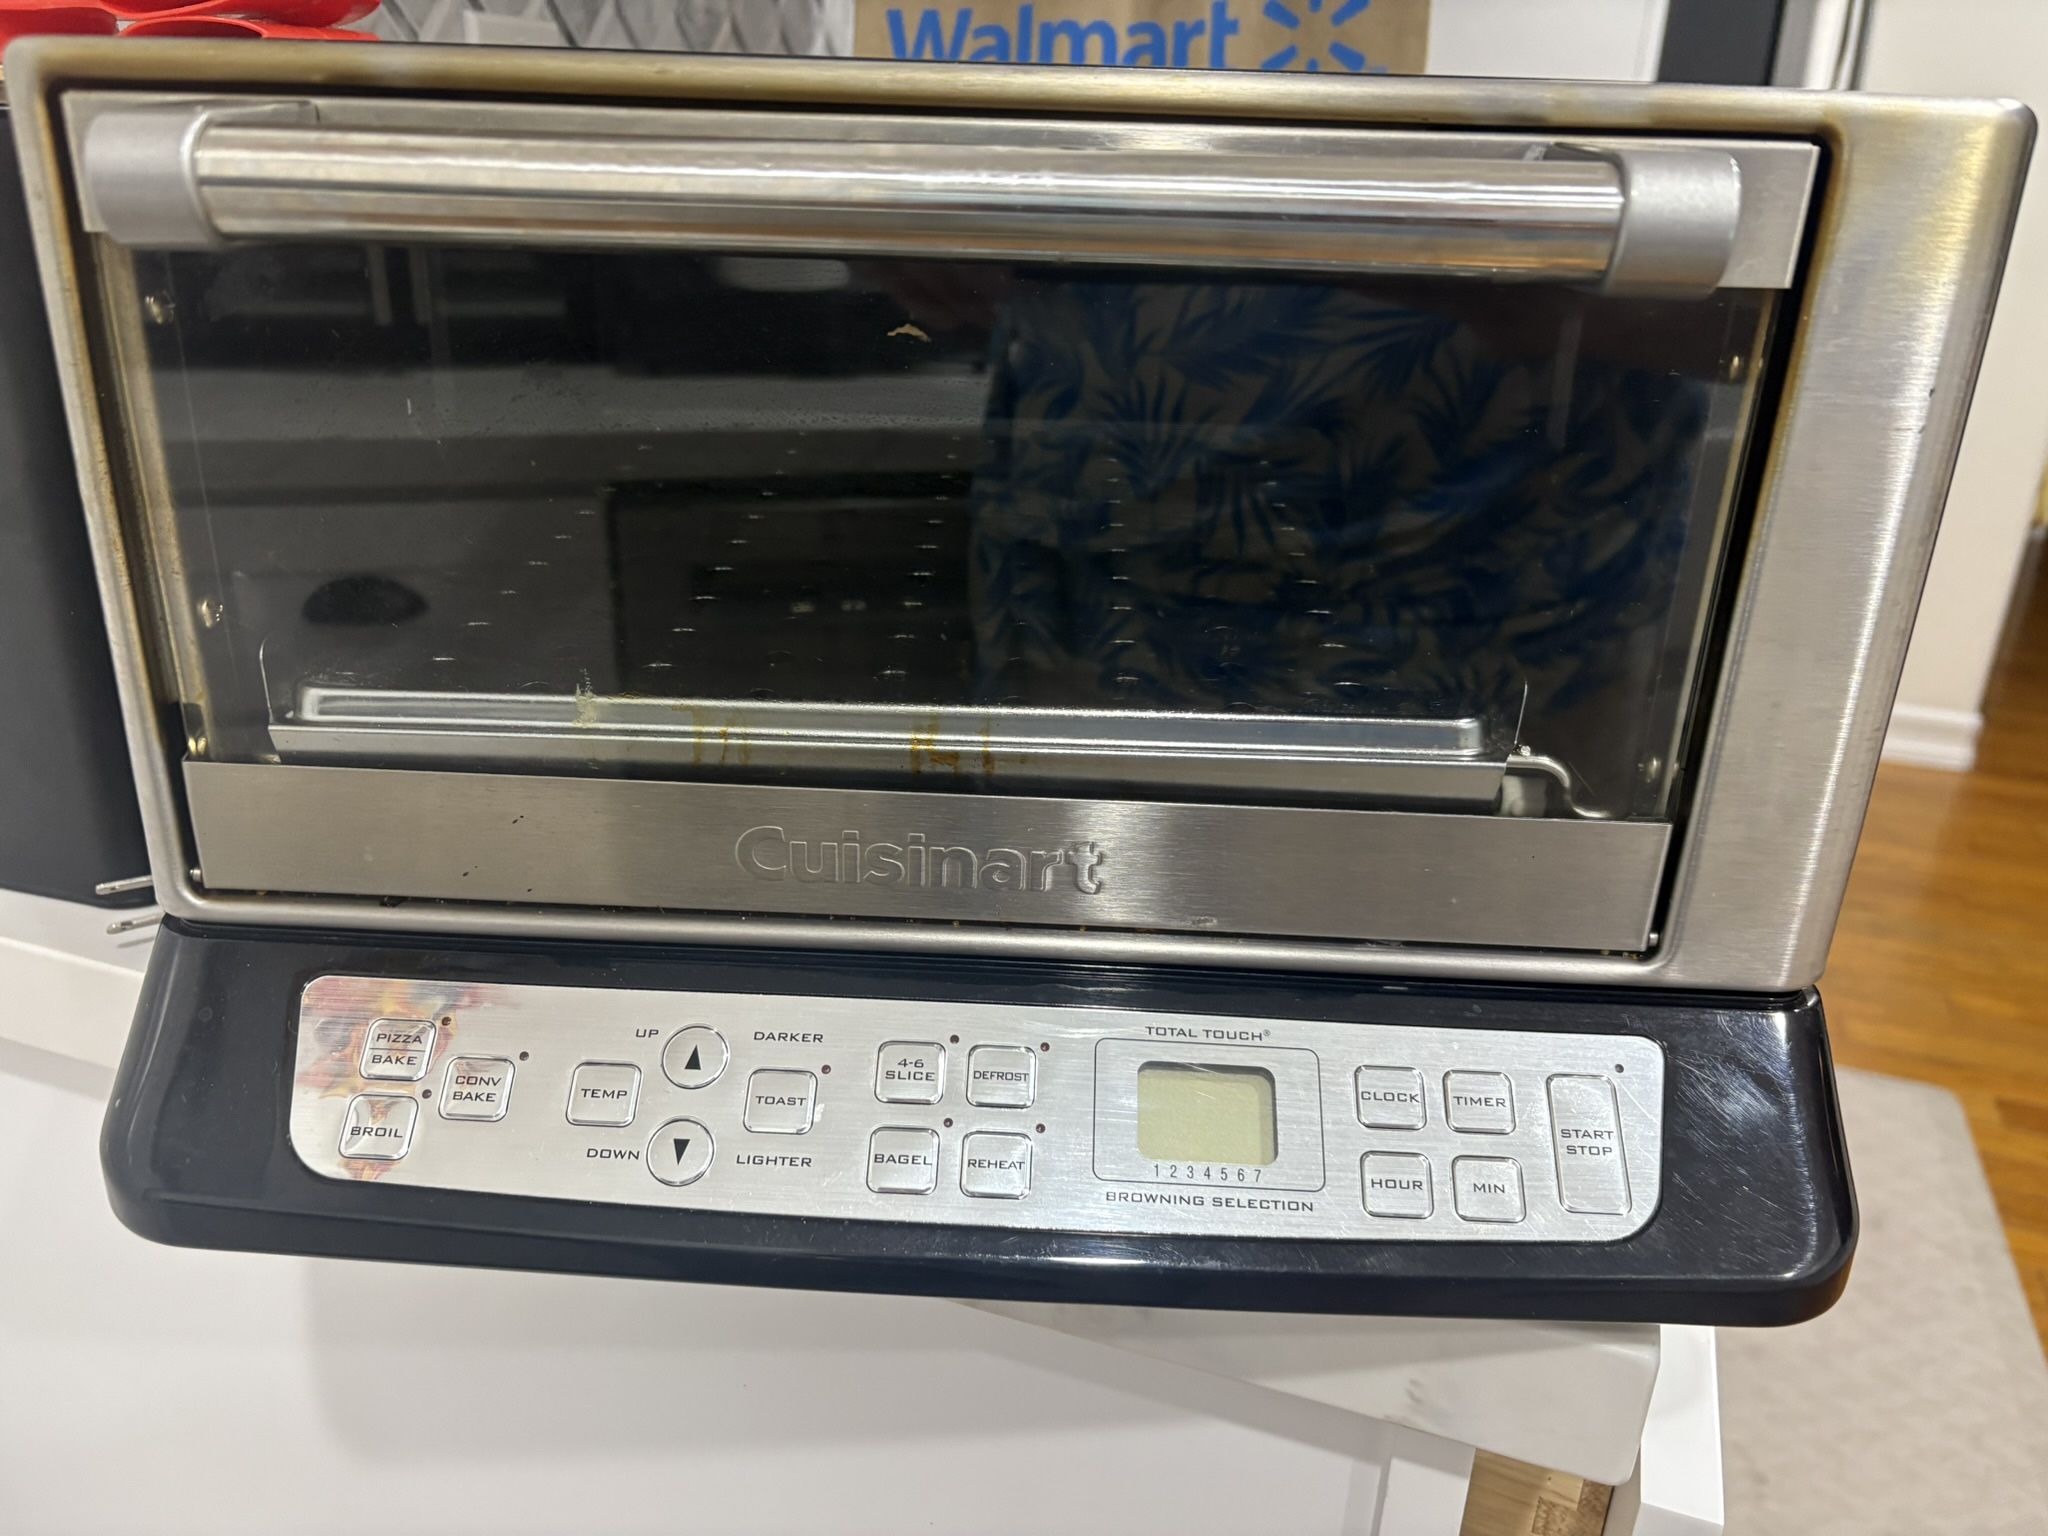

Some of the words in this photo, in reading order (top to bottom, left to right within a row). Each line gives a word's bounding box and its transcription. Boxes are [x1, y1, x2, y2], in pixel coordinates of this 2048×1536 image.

[887, 0, 1239, 69] Walmart
[735, 825, 1104, 894] Cuisinart
[636, 1028, 659, 1038] UP
[754, 1031, 824, 1043] DARKER
[1145, 1026, 1197, 1038] TOTAL
[376, 1033, 423, 1044] PIZZA
[371, 1054, 417, 1065] BAKE
[897, 1059, 924, 1068] 4-6
[455, 1075, 502, 1086] CONV
[885, 1070, 935, 1082] SLICE
[973, 1070, 1029, 1082] DEFROST
[452, 1091, 496, 1102] BAKE
[581, 1088, 628, 1099] TEMP
[1361, 1090, 1420, 1103] CLOCK
[755, 1095, 807, 1106] TOAST
[1453, 1096, 1506, 1108] TIMER
[350, 1126, 403, 1138] BROIL
[1561, 1128, 1614, 1140] START
[586, 1148, 640, 1161] DOWN
[1566, 1145, 1613, 1156] STOP
[736, 1154, 812, 1167] LIGHTER
[874, 1153, 932, 1166] BAGEL
[967, 1158, 1025, 1170] REHEAT
[1170, 1165, 1177, 1178] 2
[1187, 1165, 1194, 1179] 3
[1203, 1166, 1211, 1180] 4
[1220, 1167, 1228, 1181] 5
[1237, 1168, 1245, 1182] 6
[1254, 1169, 1262, 1182] 7
[1371, 1178, 1423, 1191] HOUR
[1473, 1183, 1505, 1194] MIN
[1106, 1191, 1204, 1206] BROWNING
[1212, 1197, 1314, 1212] SELECTION
